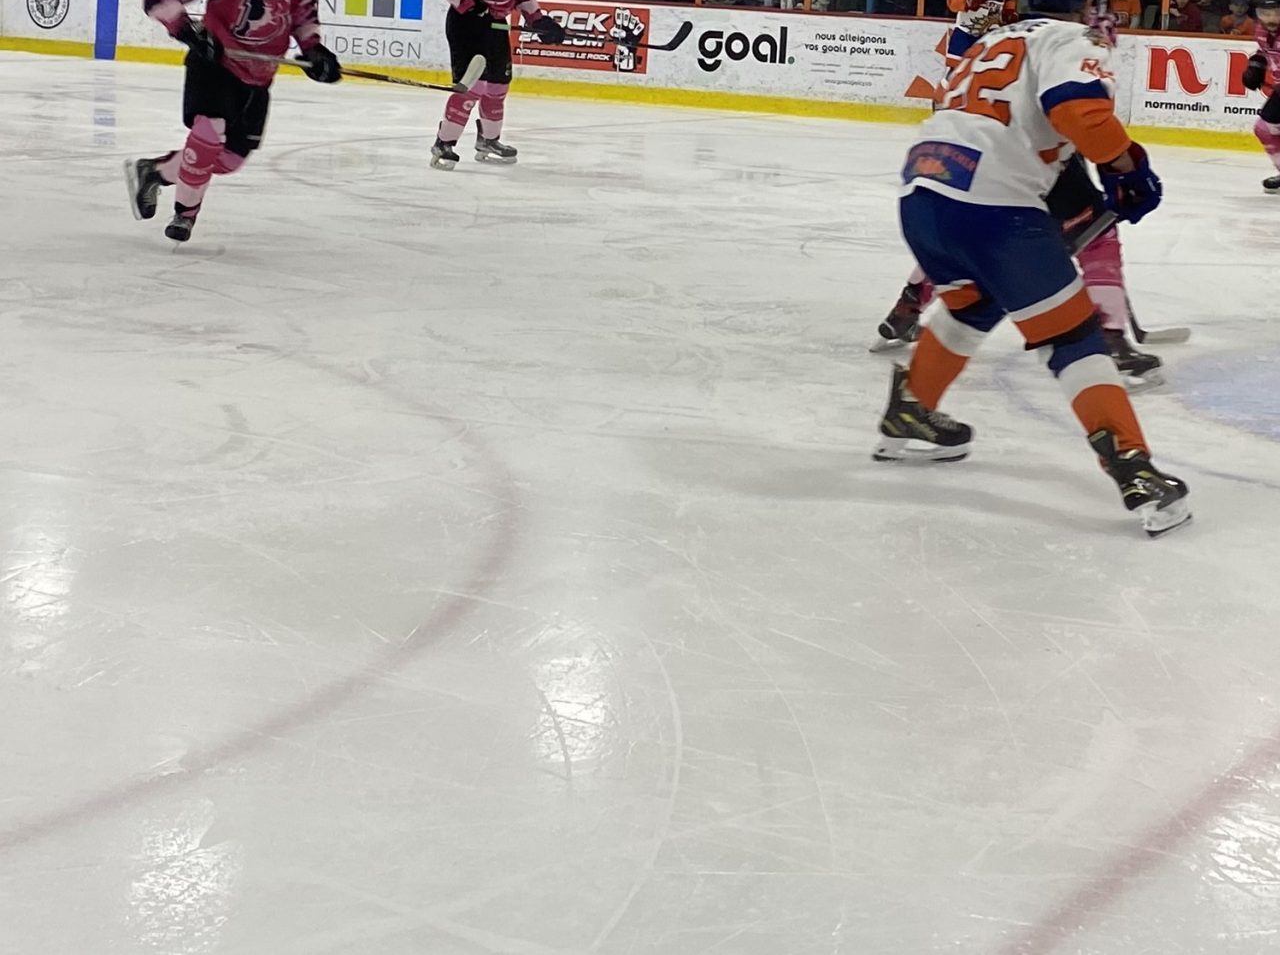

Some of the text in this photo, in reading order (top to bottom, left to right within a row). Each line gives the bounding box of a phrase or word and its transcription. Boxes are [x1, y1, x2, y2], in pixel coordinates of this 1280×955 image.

[815, 32, 886, 44] nous atteignons
[334, 36, 421, 59] DESIGN
[540, 49, 575, 58] SOMMES
[697, 26, 796, 72] goal.
[805, 43, 896, 56] vos goals pour vous.
[1145, 99, 1210, 113] normandin
[1224, 105, 1262, 115] norma
